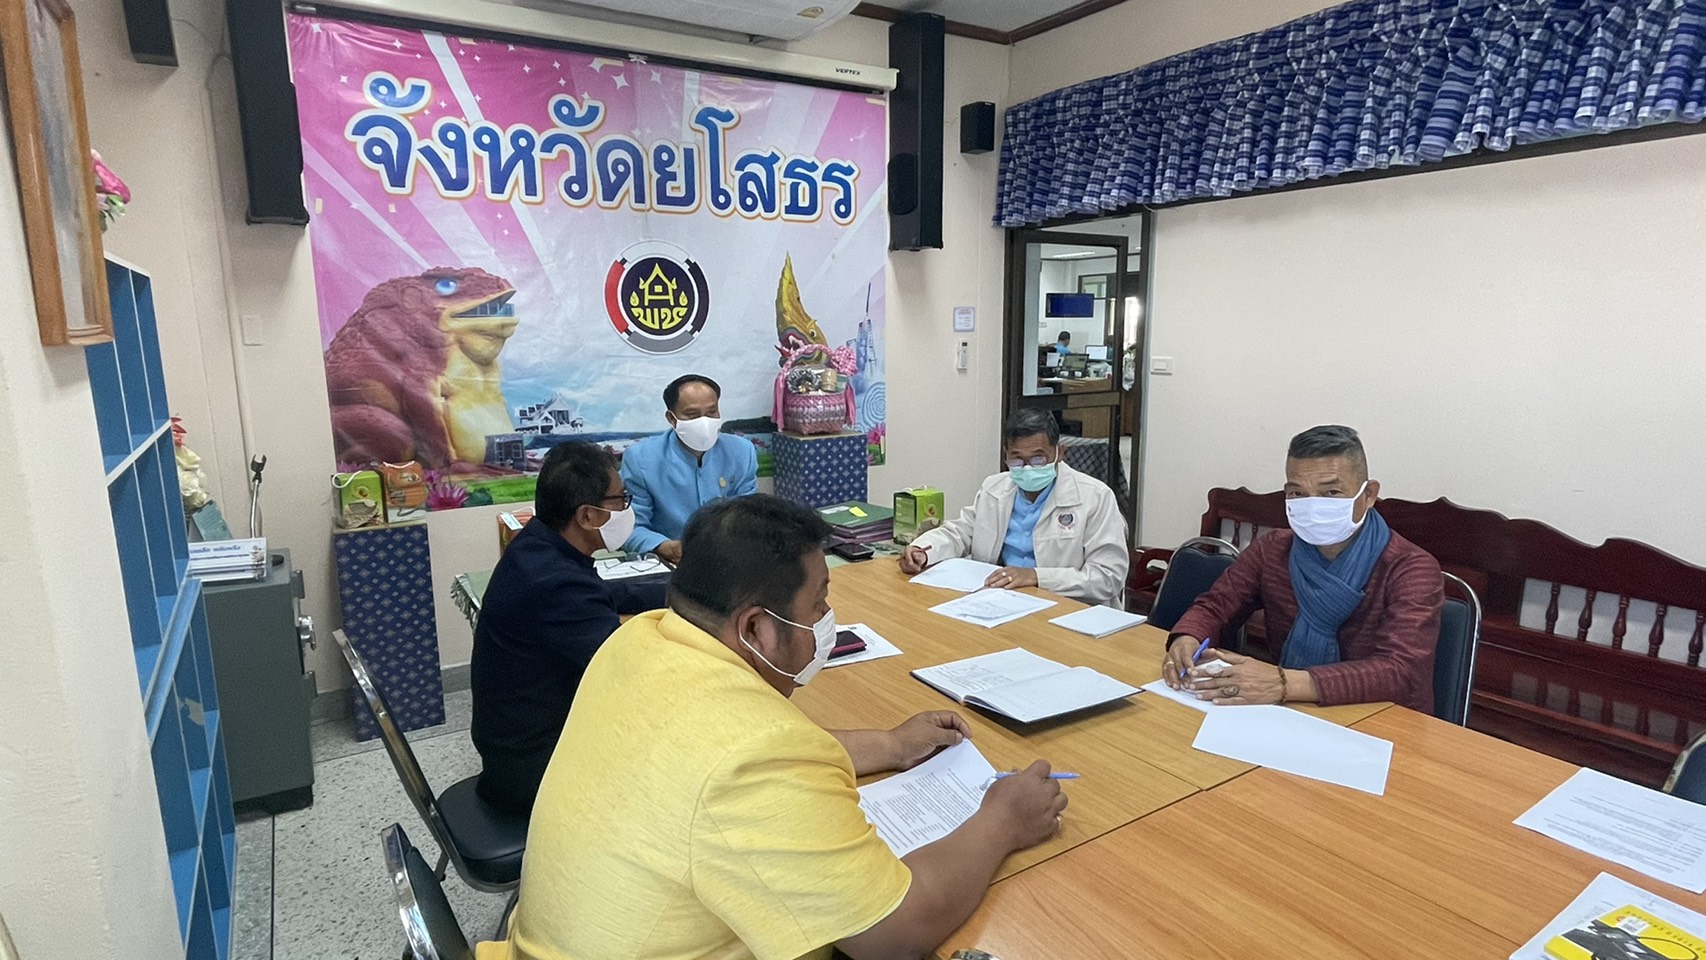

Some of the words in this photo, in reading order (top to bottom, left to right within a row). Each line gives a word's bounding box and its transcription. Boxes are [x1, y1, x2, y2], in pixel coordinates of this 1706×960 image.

[835, 67, 861, 75] VERTEX
[347, 73, 859, 223] จังหวัดยโสธร
